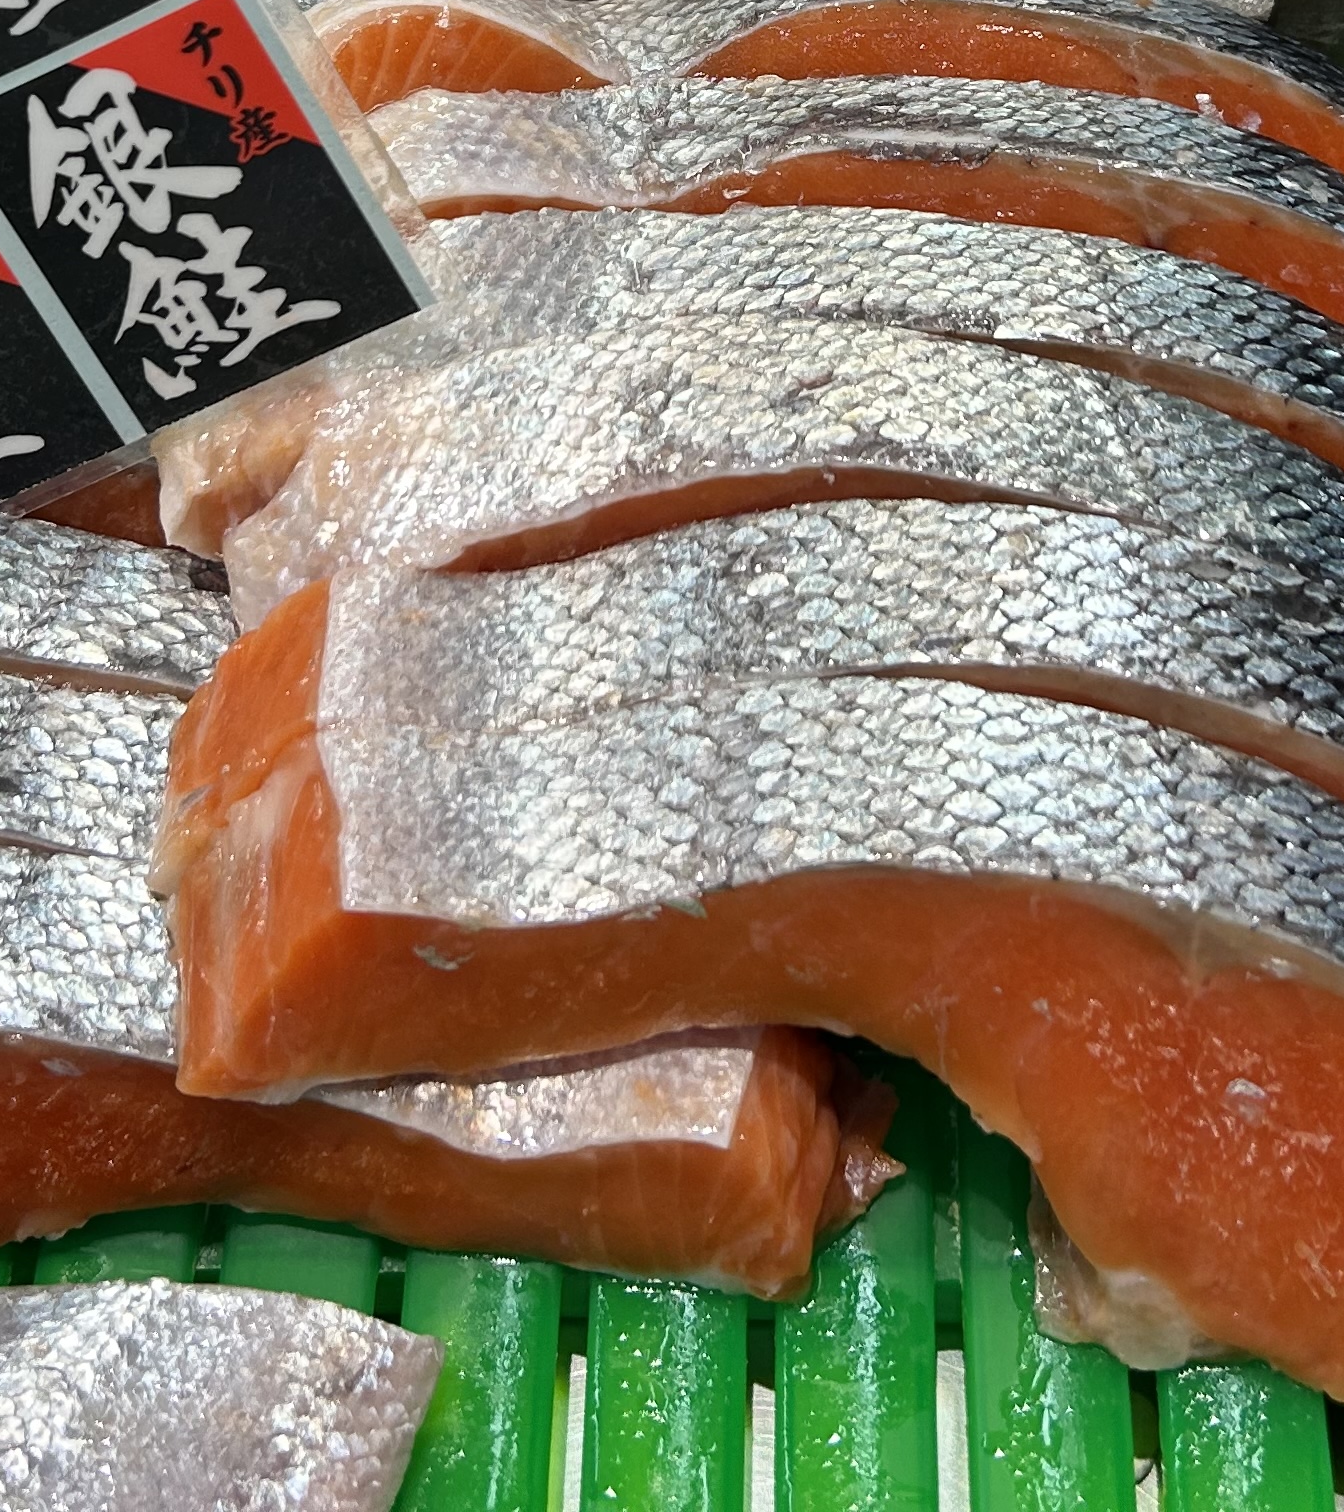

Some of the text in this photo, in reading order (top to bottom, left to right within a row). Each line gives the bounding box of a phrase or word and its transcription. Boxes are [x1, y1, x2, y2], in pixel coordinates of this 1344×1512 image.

[181, 21, 292, 163] チリ産
[27, 68, 341, 400] 銀鮭
